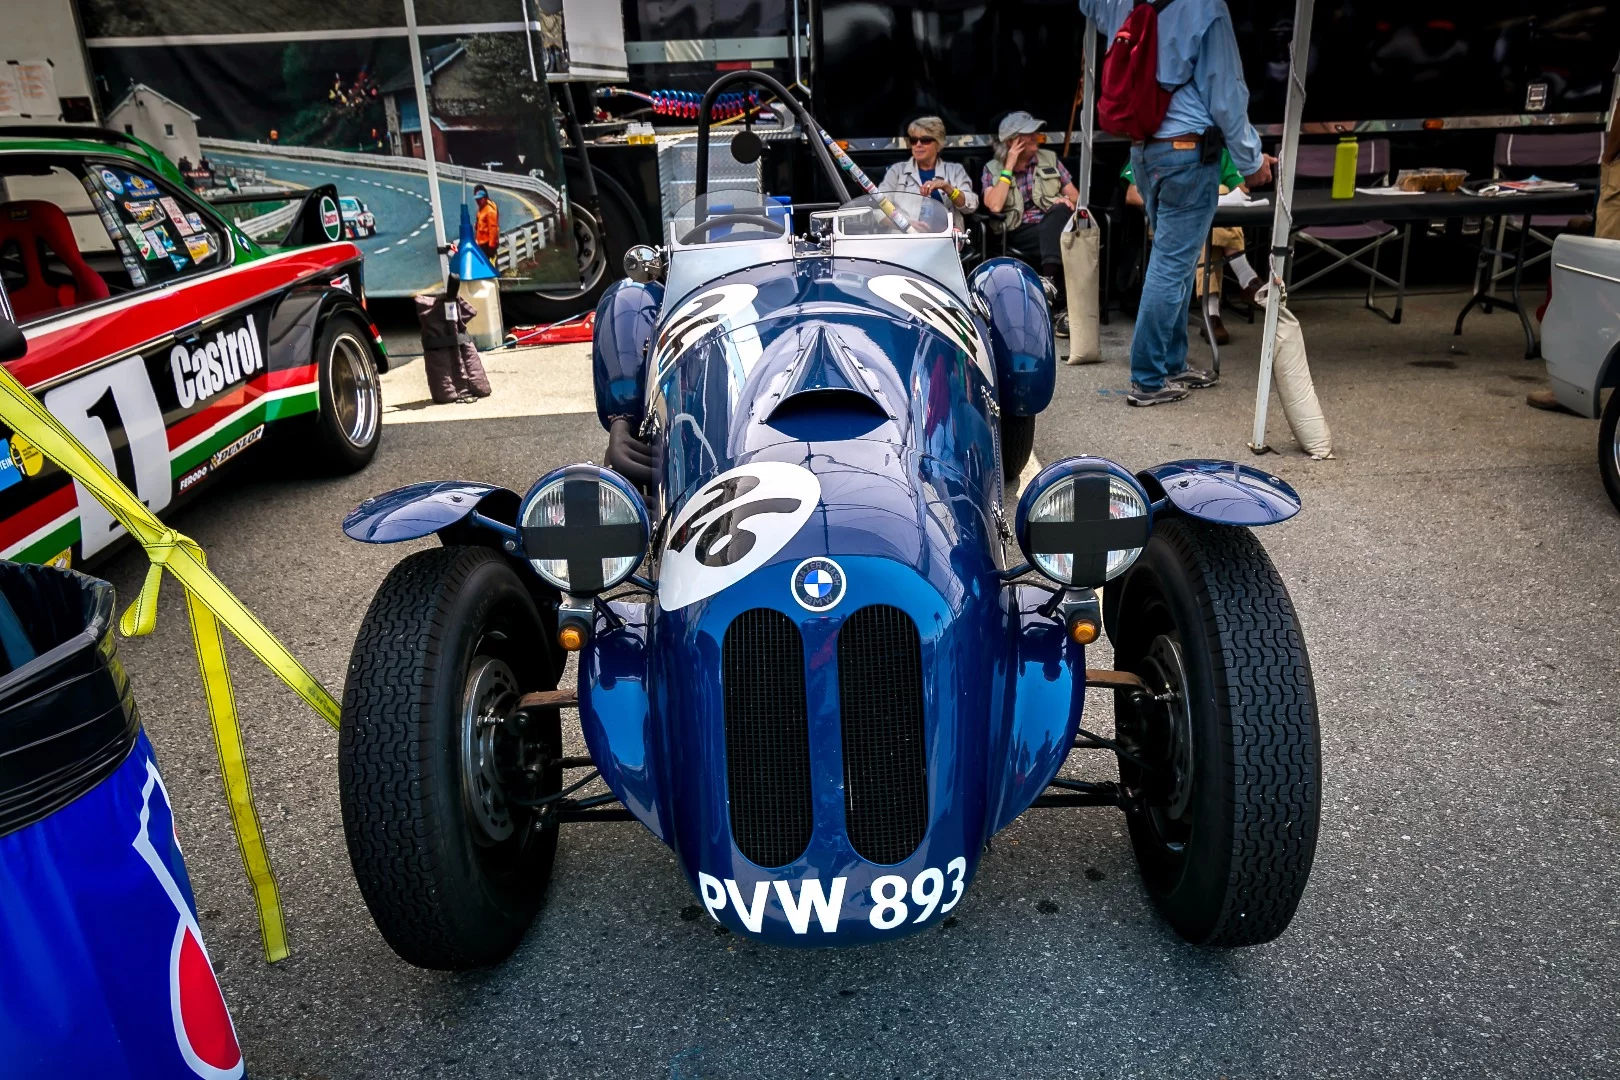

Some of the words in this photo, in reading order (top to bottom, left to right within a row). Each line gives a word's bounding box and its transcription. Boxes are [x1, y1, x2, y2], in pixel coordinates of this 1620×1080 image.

[170, 314, 263, 409] Castrol
[657, 293, 731, 376] 26
[86, 385, 149, 532] 1
[180, 466, 208, 490] FERODO
[220, 427, 262, 462] DUNLOP
[667, 475, 802, 568] 26
[796, 561, 822, 588] FRAZER
[824, 562, 841, 586] NASH
[803, 594, 834, 606] BMW
[698, 871, 848, 935] PVW
[869, 856, 967, 930] 893
